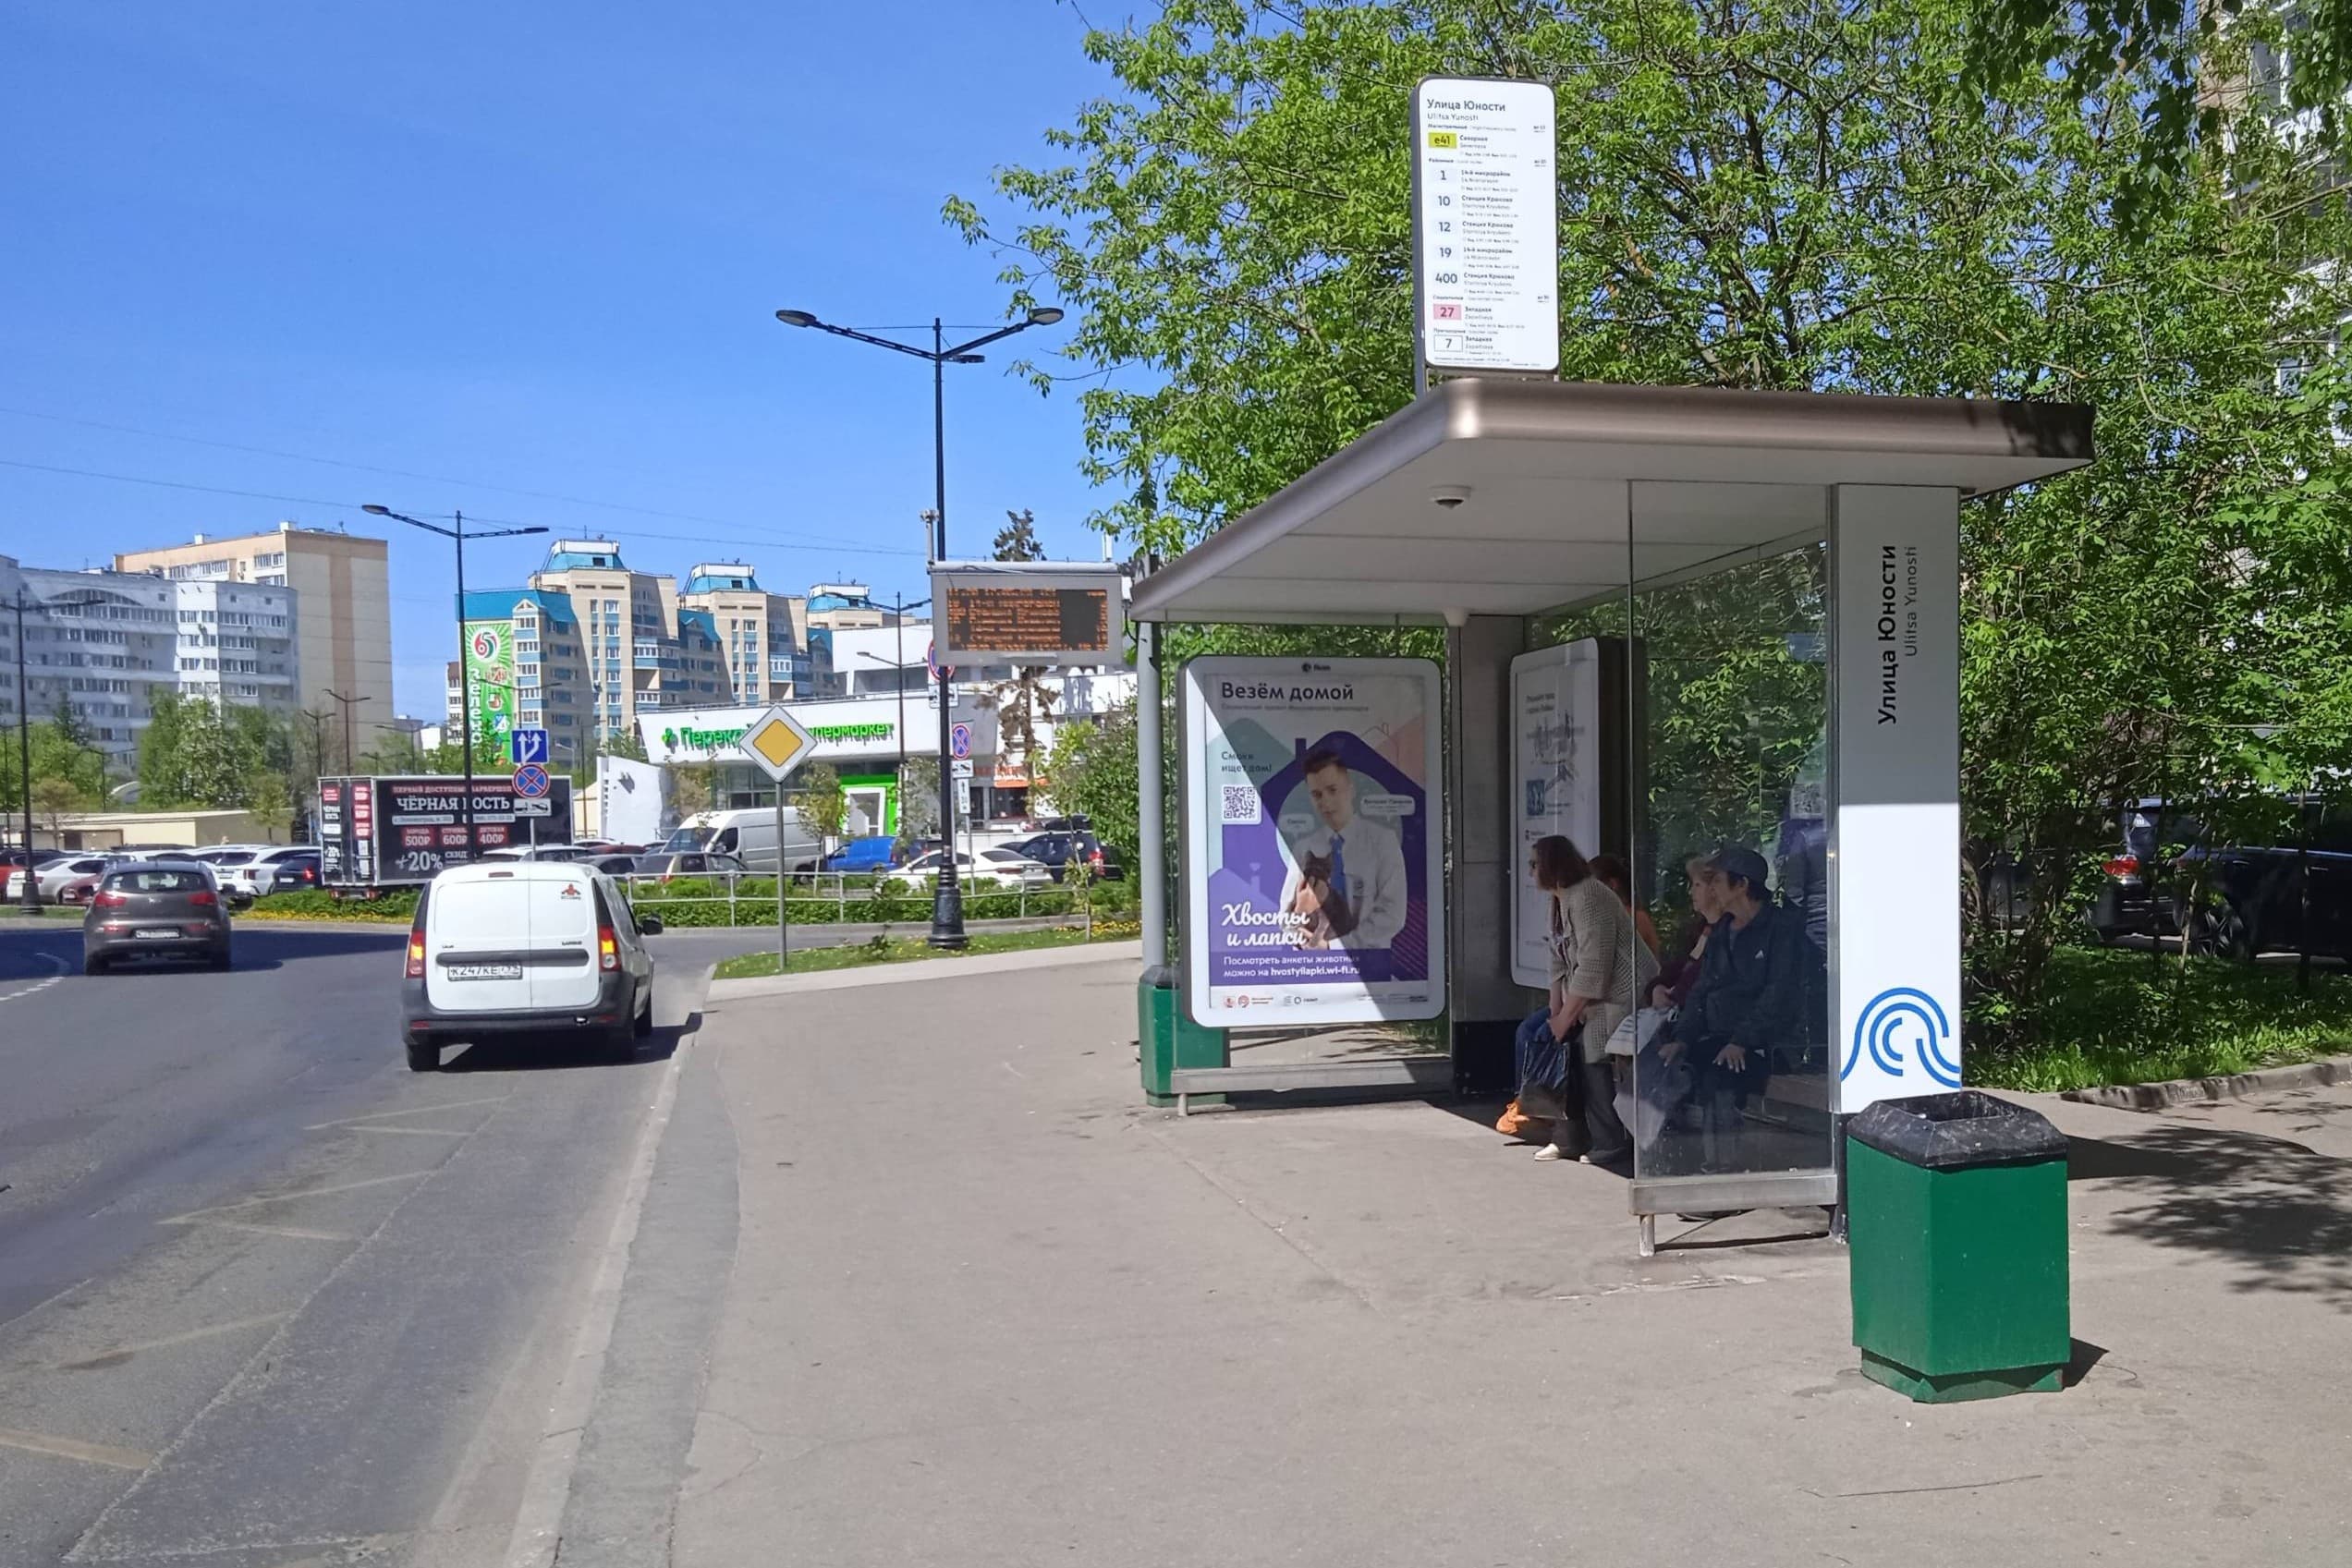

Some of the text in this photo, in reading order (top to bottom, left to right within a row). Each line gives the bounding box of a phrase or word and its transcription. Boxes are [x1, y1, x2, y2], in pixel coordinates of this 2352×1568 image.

[1427, 99, 1505, 111] Улица Юности
[1434, 136, 1450, 145] e41
[1441, 170, 1446, 180] 1
[1438, 195, 1451, 206] 10
[1439, 222, 1451, 232] 12
[1440, 247, 1452, 258] 19
[1435, 273, 1457, 284] 400
[1440, 307, 1455, 318] 27
[1445, 338, 1452, 348] 7
[1905, 546, 1918, 657] Ulitsa Yunosti
[1878, 545, 1898, 724] Улица Юности
[1222, 682, 1354, 702] Везём домой
[1222, 763, 1272, 773] ищет дом!
[396, 796, 458, 811] ЧЁРНАЯ
[395, 851, 443, 871] +20%
[1221, 901, 1310, 929] Хвосты
[1227, 931, 1307, 946] и лапки
[1224, 956, 1280, 967] Посмотреть
[1282, 955, 1314, 965] анкеты
[1271, 965, 1360, 977] hvostyilapki.wi-fi.ru
